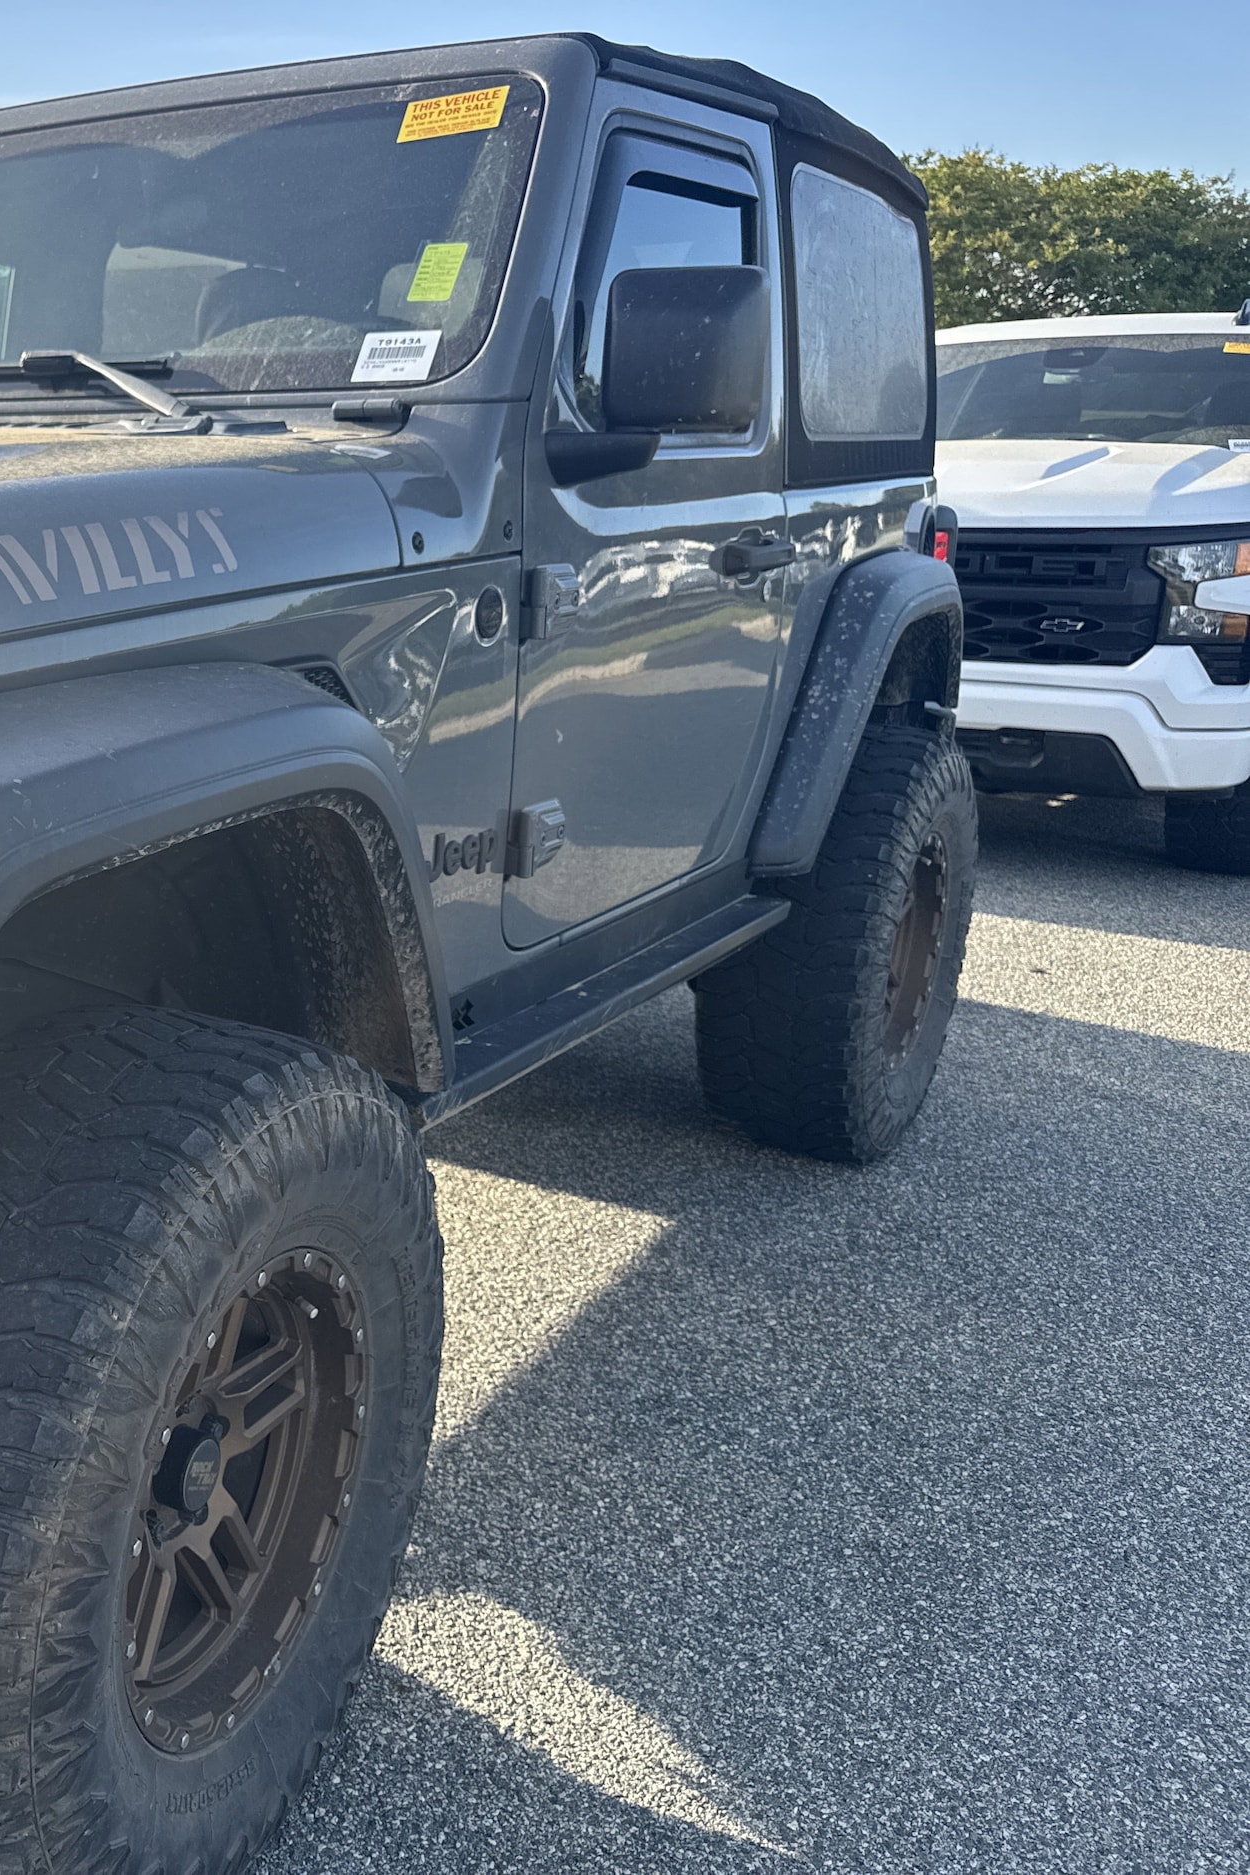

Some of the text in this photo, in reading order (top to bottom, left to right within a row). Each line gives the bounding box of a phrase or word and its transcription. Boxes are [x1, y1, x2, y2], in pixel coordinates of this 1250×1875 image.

[410, 111, 435, 122] NOT
[437, 106, 461, 118] FOR
[464, 101, 495, 113] SALE
[412, 89, 502, 114] THIS VEHICLE
[378, 337, 422, 347] T9143A
[428, 828, 498, 883] Jeep
[433, 878, 493, 908] RANGLER
